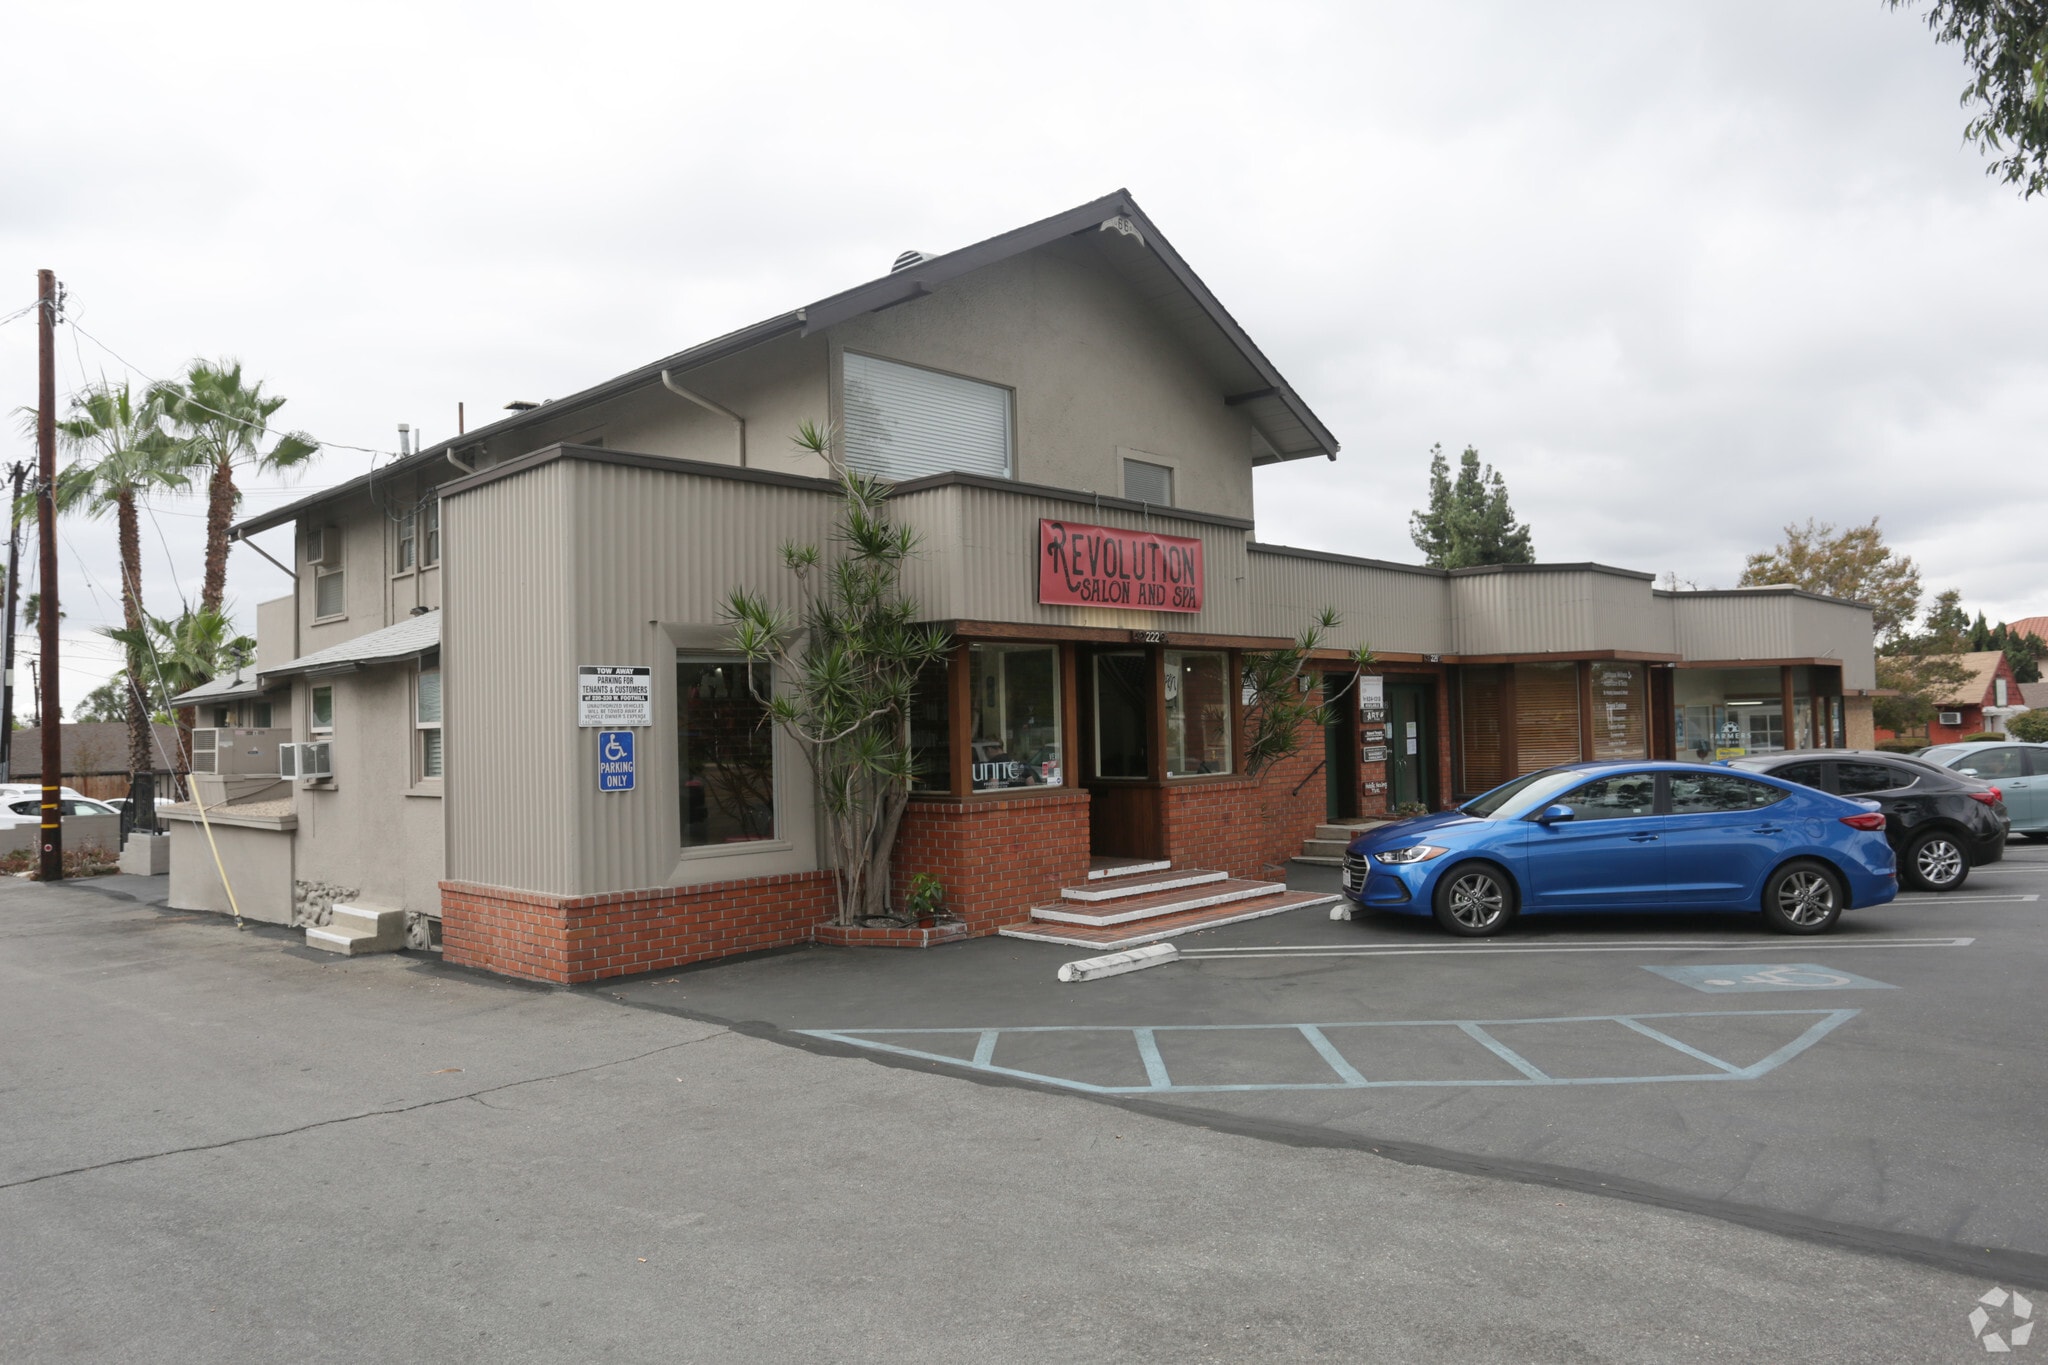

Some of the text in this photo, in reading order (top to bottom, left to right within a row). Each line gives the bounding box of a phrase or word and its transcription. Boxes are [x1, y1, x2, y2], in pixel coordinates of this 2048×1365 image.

[1047, 522, 1195, 593] REVOLUTION
[1080, 578, 1196, 608] SALON AND SPA
[1145, 631, 1160, 643] 222
[597, 676, 634, 685] PARKING FOR
[582, 685, 609, 694] TENANTS
[614, 686, 648, 694] CUSTOMERS
[1709, 732, 1752, 740] FARMERS
[600, 761, 633, 774] PARKING
[606, 775, 628, 787] ONLY
